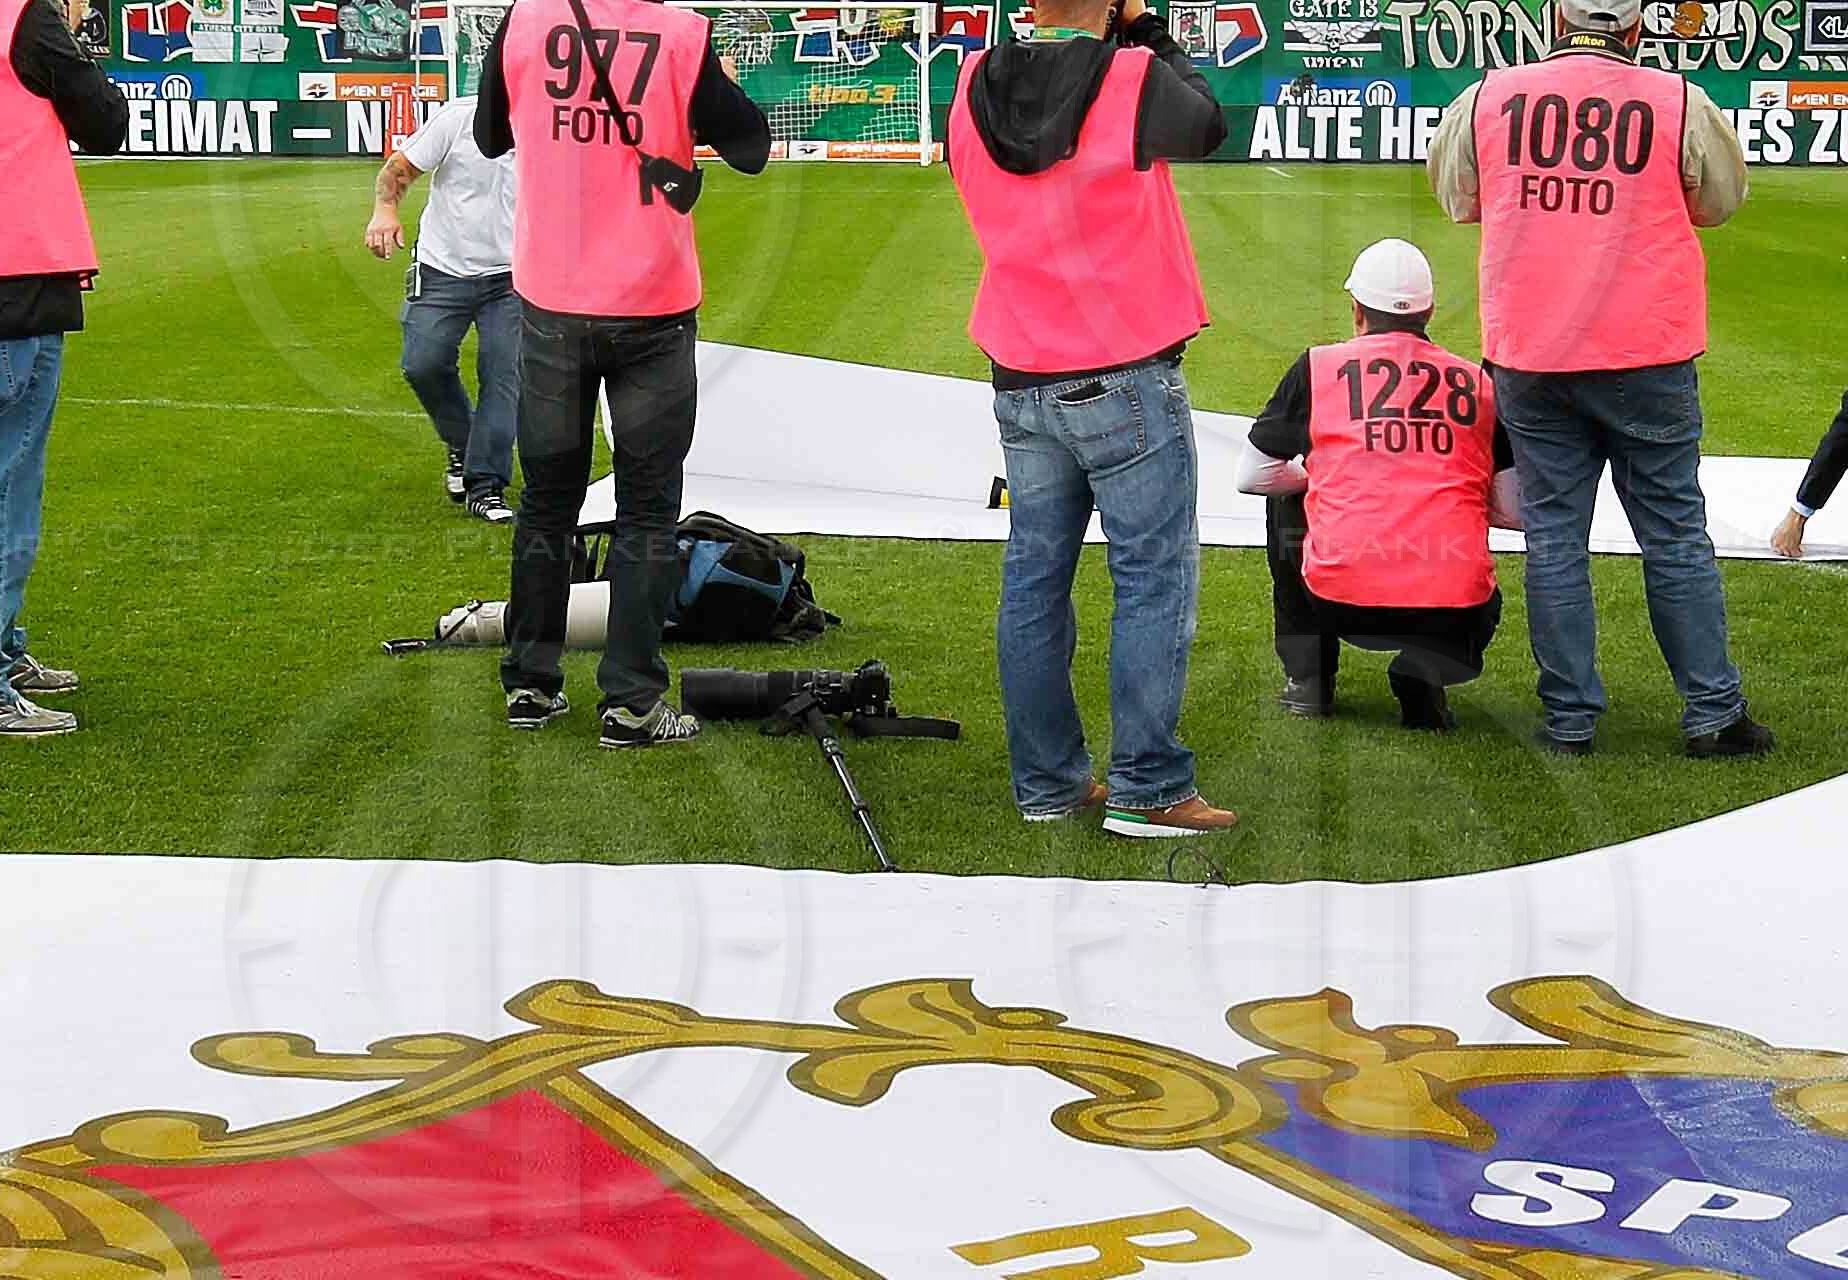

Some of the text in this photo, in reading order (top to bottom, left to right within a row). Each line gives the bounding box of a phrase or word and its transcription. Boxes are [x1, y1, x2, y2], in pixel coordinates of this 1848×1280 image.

[1570, 35, 1607, 48] Nikon
[544, 24, 662, 107] 977
[340, 85, 377, 97] WIEN
[1792, 94, 1829, 107] WIEN
[552, 105, 644, 146] FOTO
[1249, 106, 1362, 160] ALTE
[1500, 93, 1655, 176] 1080
[1520, 175, 1615, 216] FOTO
[1337, 358, 1478, 427] 1228
[1364, 420, 1454, 457] FOTO
